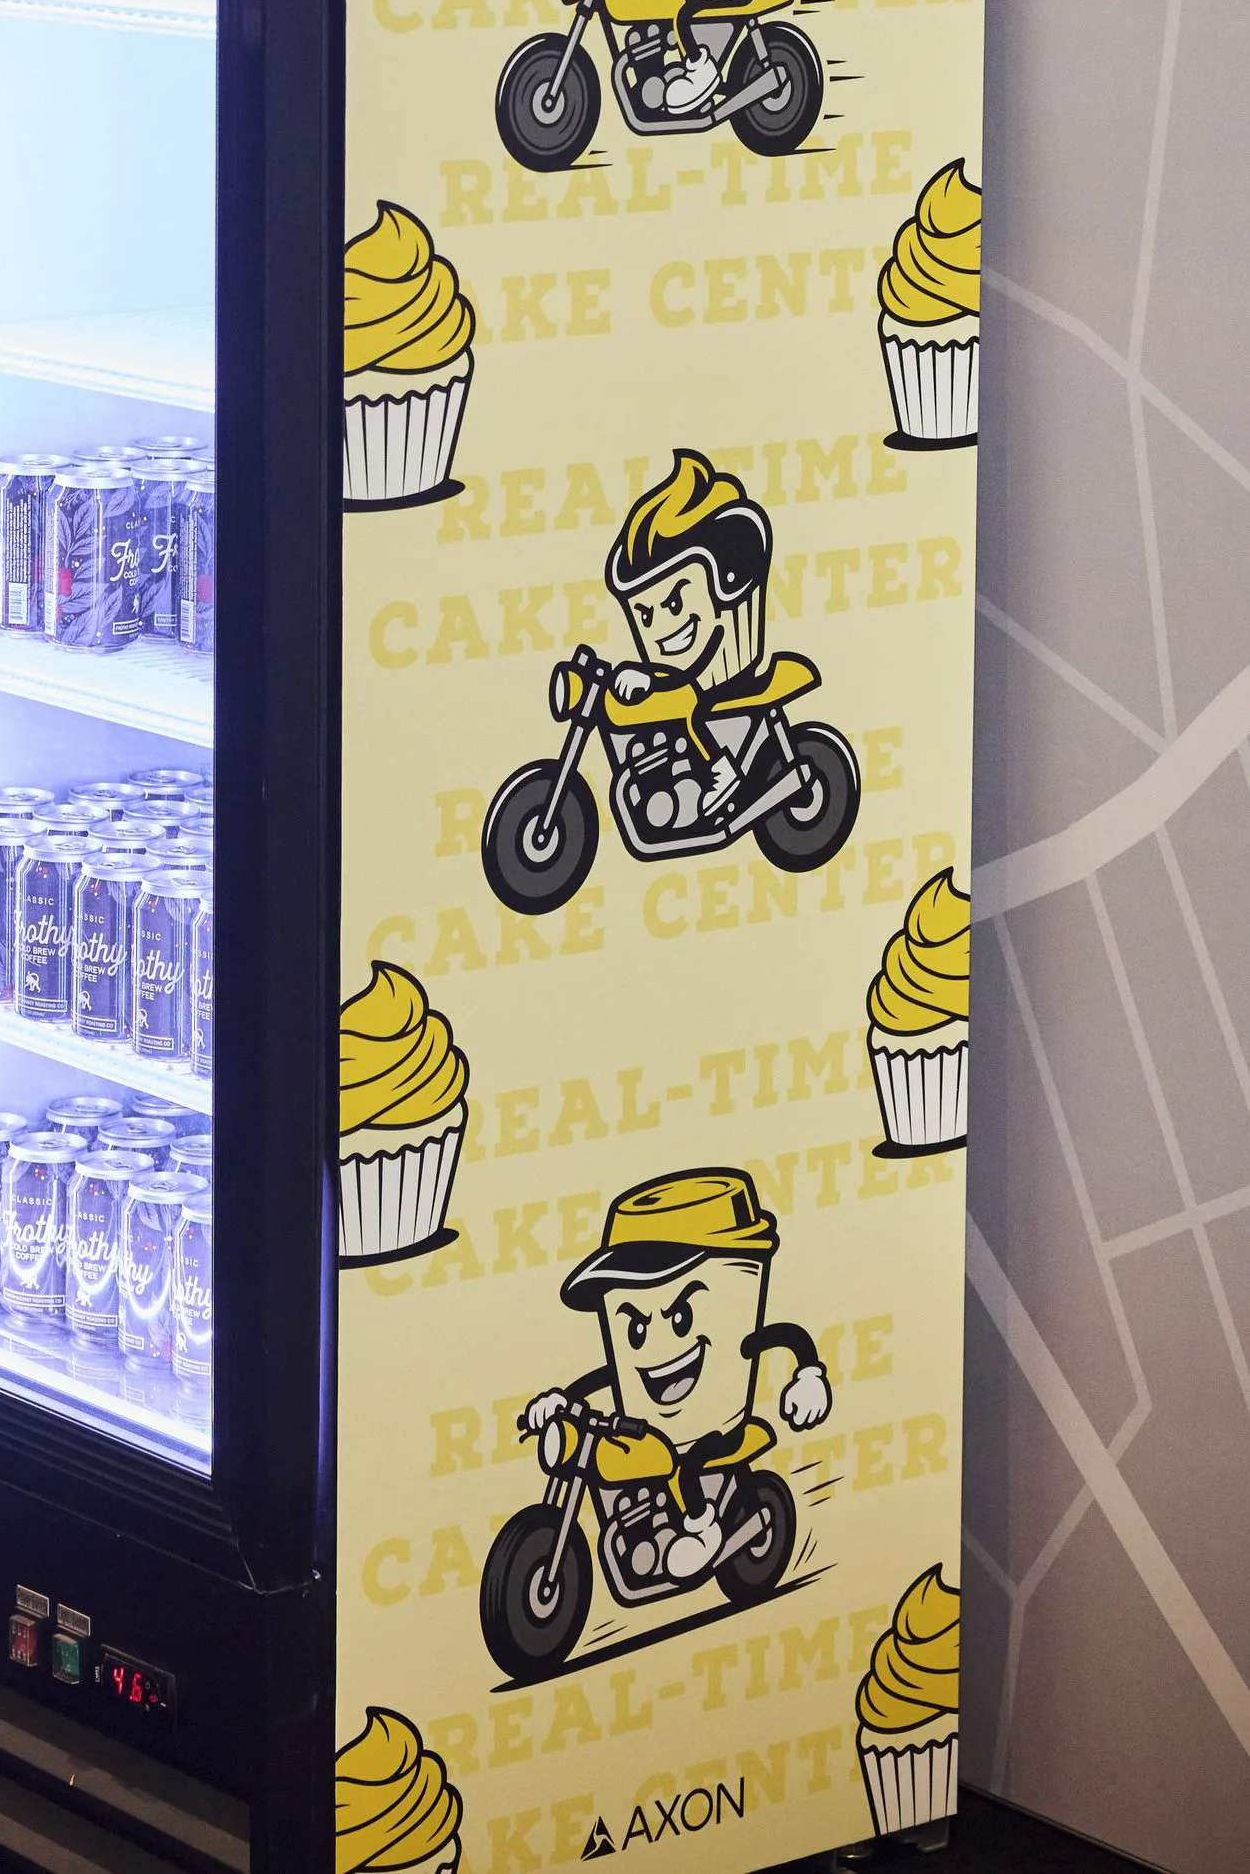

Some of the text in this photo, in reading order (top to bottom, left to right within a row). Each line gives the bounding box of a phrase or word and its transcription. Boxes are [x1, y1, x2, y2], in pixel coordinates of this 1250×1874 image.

[438, 129, 914, 228] REAL-TIME
[458, 244, 891, 345] KE CENT
[437, 429, 909, 544] REATIME
[110, 538, 140, 582] Fro
[368, 536, 963, 669] CAKE NTER
[19, 893, 55, 906] ASSIC
[81, 913, 105, 925] SSIC
[366, 830, 957, 979] CAKE CENTER
[33, 947, 56, 957] BREW
[75, 932, 129, 976] othy
[141, 929, 162, 941] SSIC
[77, 971, 98, 983] FFEE
[84, 964, 106, 976] BREW
[136, 949, 185, 995] othy
[141, 981, 163, 993] BREW
[139, 989, 155, 1001] FFEE
[164, 1040, 172, 1048] CO
[742, 1135, 955, 1217] NTE
[12, 1193, 54, 1206] CLASSIC
[78, 1212, 105, 1223] ASSIC
[2, 1211, 71, 1253] Frothy
[72, 1230, 119, 1268] othy
[121, 1251, 153, 1296] thy
[174, 1276, 212, 1320] othy
[427, 1604, 890, 1781] REAL-TIME
[460, 1721, 863, 1874] KE CENT
[621, 1776, 748, 1853] AXON
